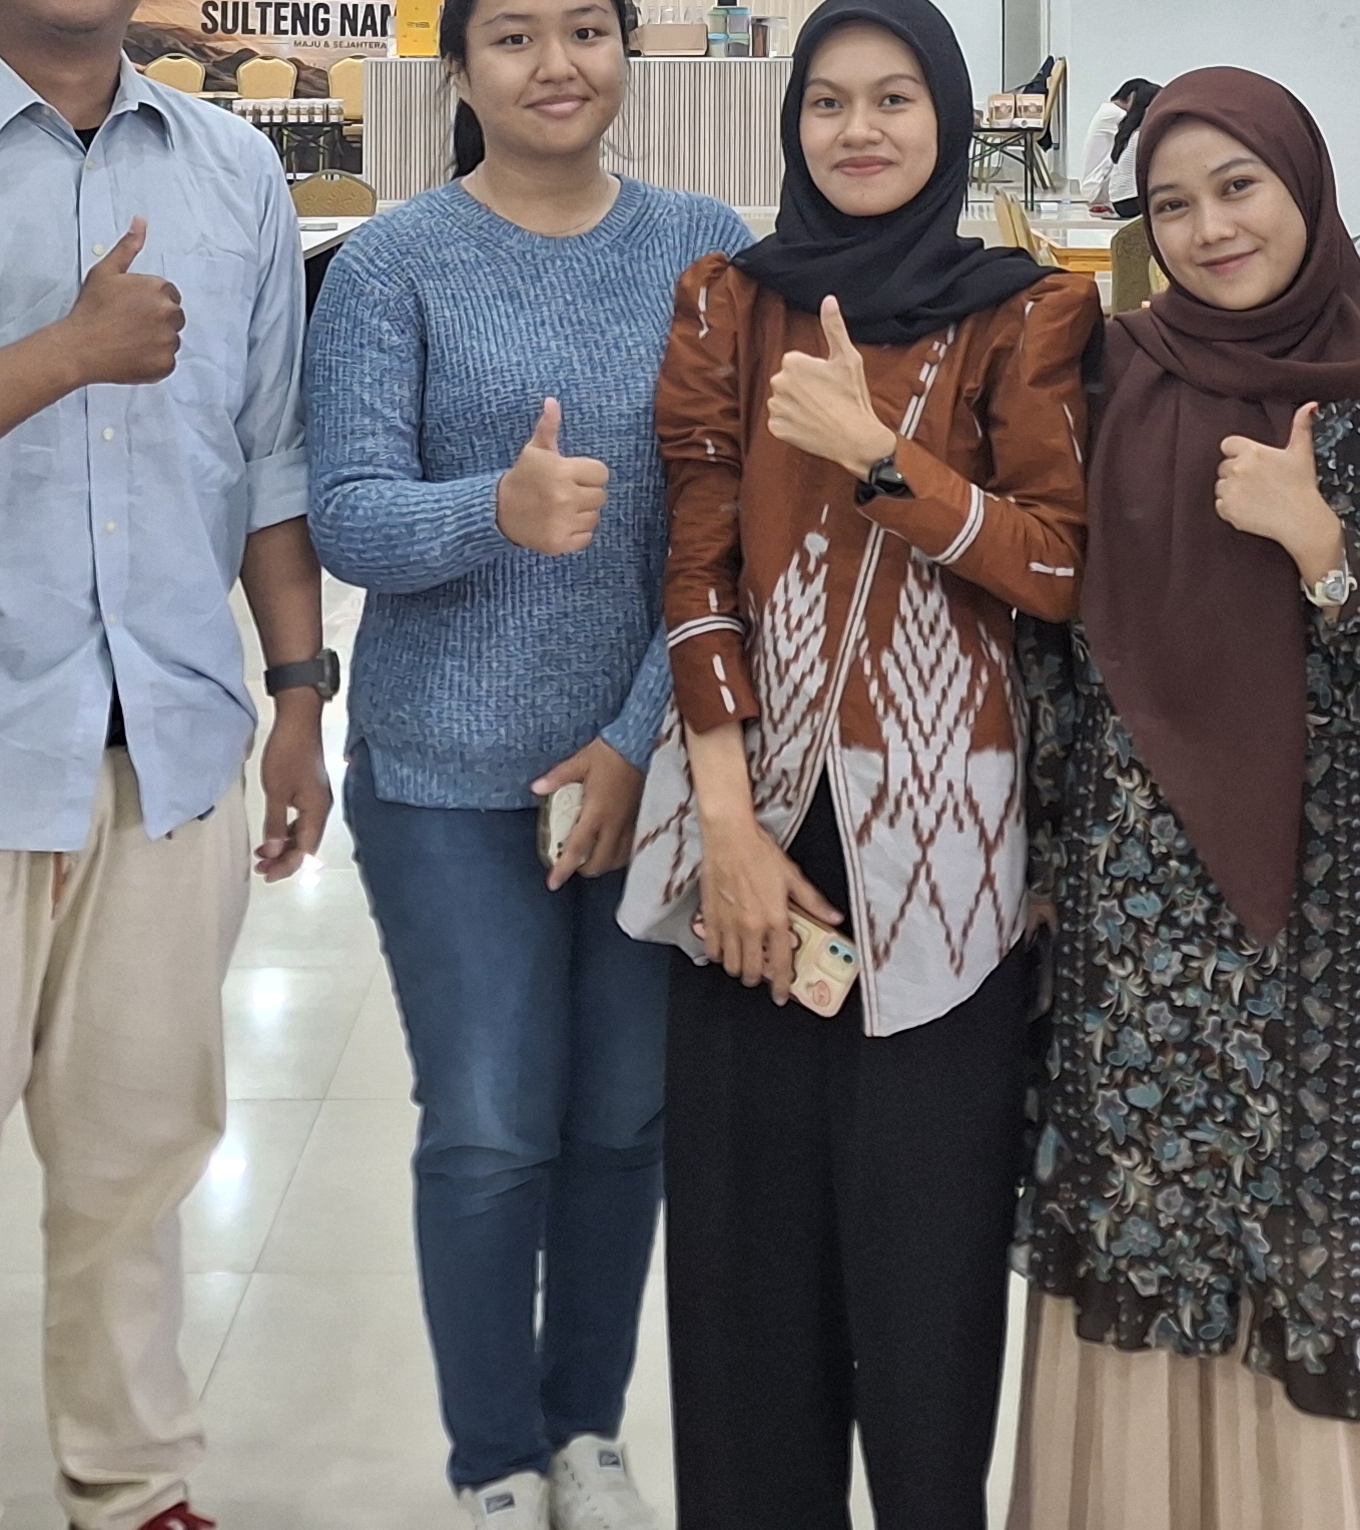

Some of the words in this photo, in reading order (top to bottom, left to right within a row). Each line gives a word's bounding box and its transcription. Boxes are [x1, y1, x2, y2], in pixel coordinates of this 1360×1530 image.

[200, 0, 331, 37] SULTENG
[293, 40, 321, 48] MAJU
[323, 40, 330, 48] &
[332, 40, 387, 49] SEJAHTERA
